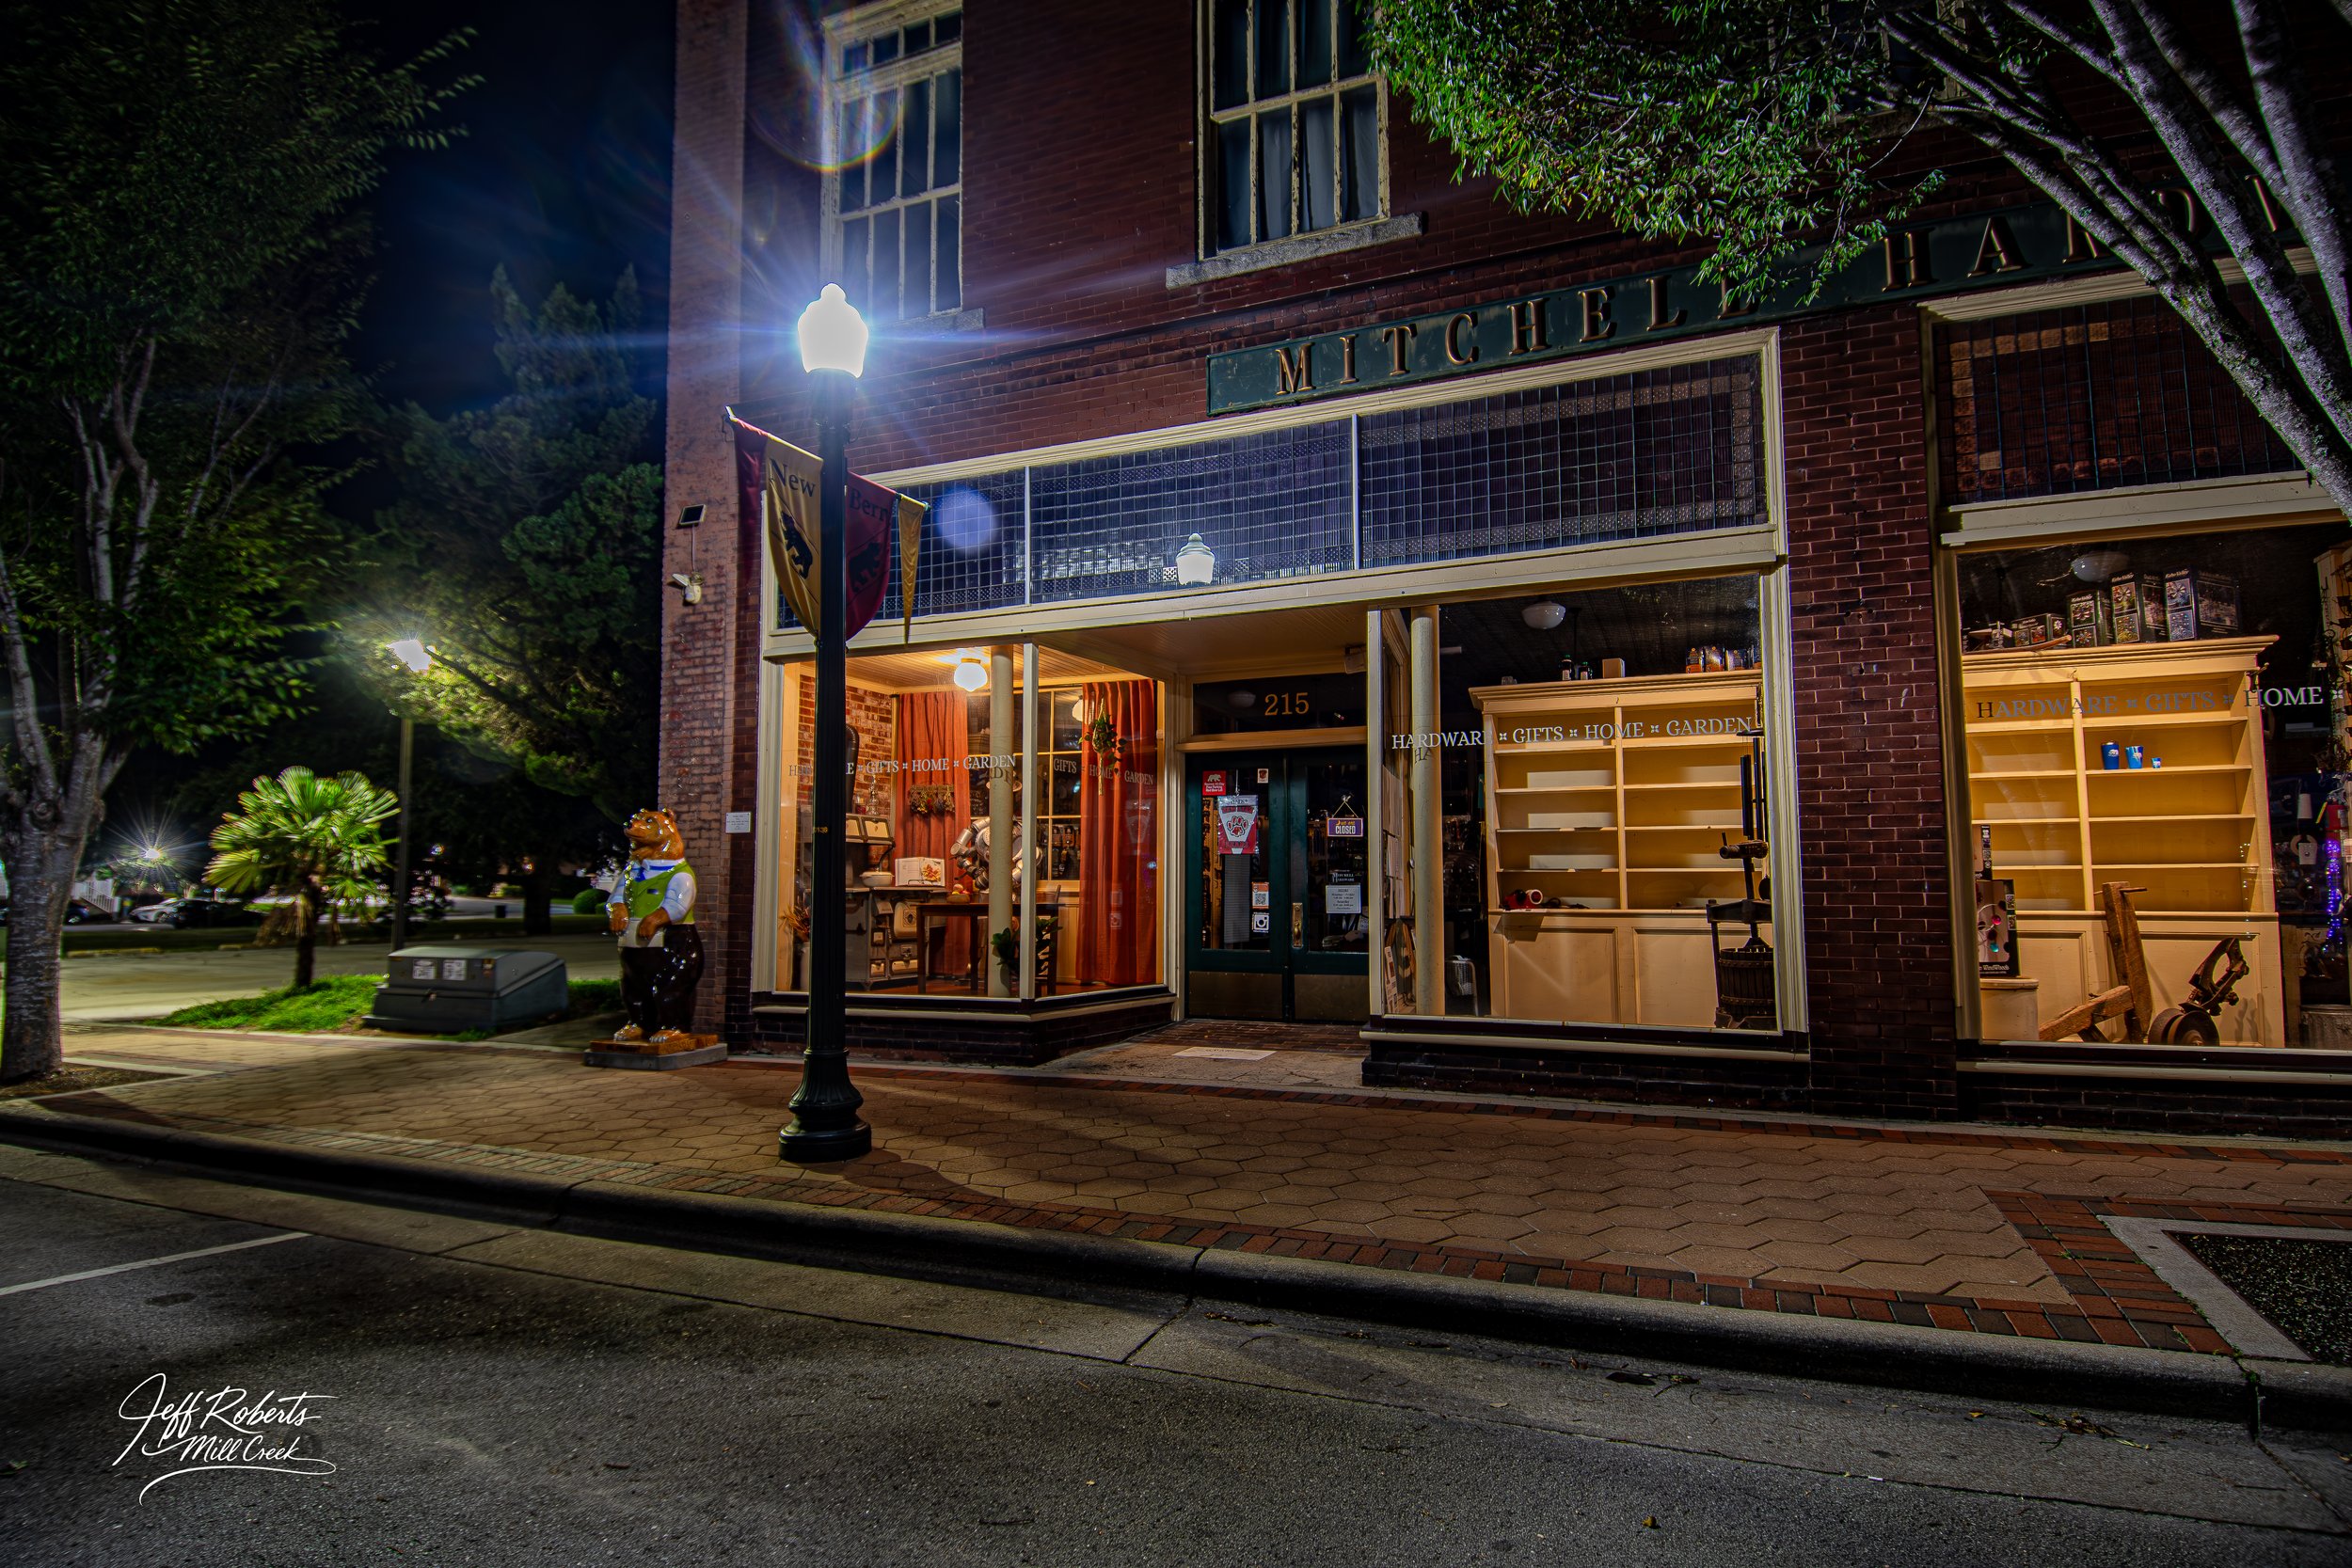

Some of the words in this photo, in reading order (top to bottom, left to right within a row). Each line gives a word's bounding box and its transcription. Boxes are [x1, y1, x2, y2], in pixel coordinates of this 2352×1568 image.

[769, 458, 816, 498] New
[850, 488, 889, 520] Bern
[1264, 691, 1310, 716] 215
[1977, 696, 2117, 718] HARDWARE
[2145, 690, 2216, 712] GIFTS
[2244, 687, 2324, 707] HOME
[1512, 725, 1564, 744] GIFTS
[1583, 721, 1645, 740] HOME
[1666, 717, 1753, 736] GARDEN
[866, 760, 898, 774] GIFTS
[912, 757, 949, 771] HOME
[962, 754, 1016, 769] GARDEN
[1054, 758, 1077, 773] GIFTS
[1089, 764, 1114, 780] HOME
[1124, 769, 1153, 784] GARDEN
[1336, 825, 1356, 834] CLOSED
